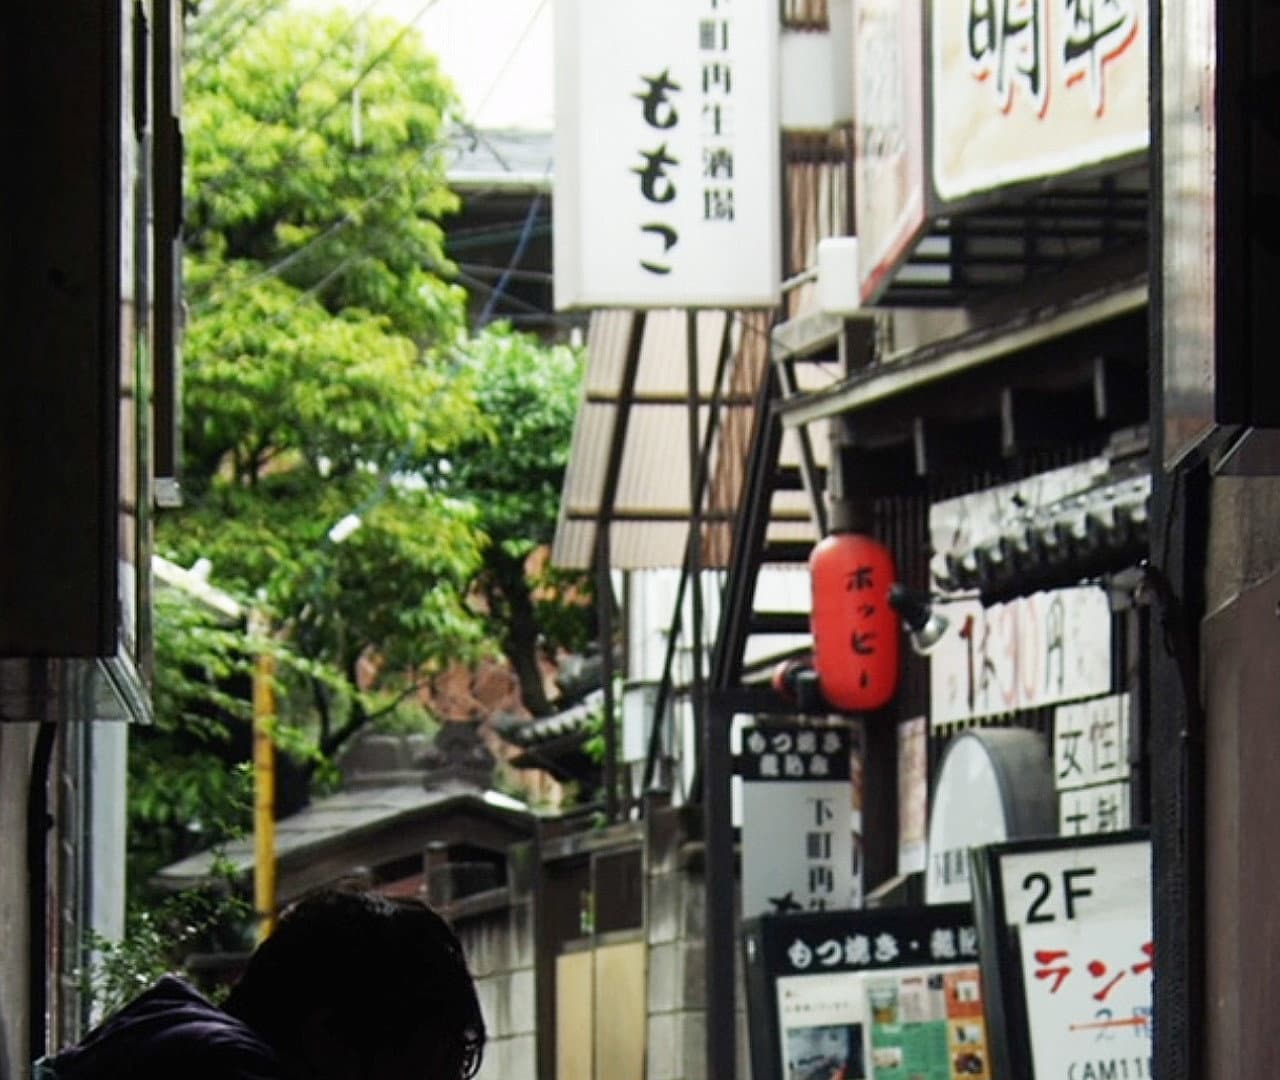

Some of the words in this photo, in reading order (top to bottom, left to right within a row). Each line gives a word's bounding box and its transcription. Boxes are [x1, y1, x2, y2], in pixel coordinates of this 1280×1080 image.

[631, 66, 683, 275] ももこ
[846, 565, 878, 691] ホッピー
[1022, 867, 1098, 925] 2F
